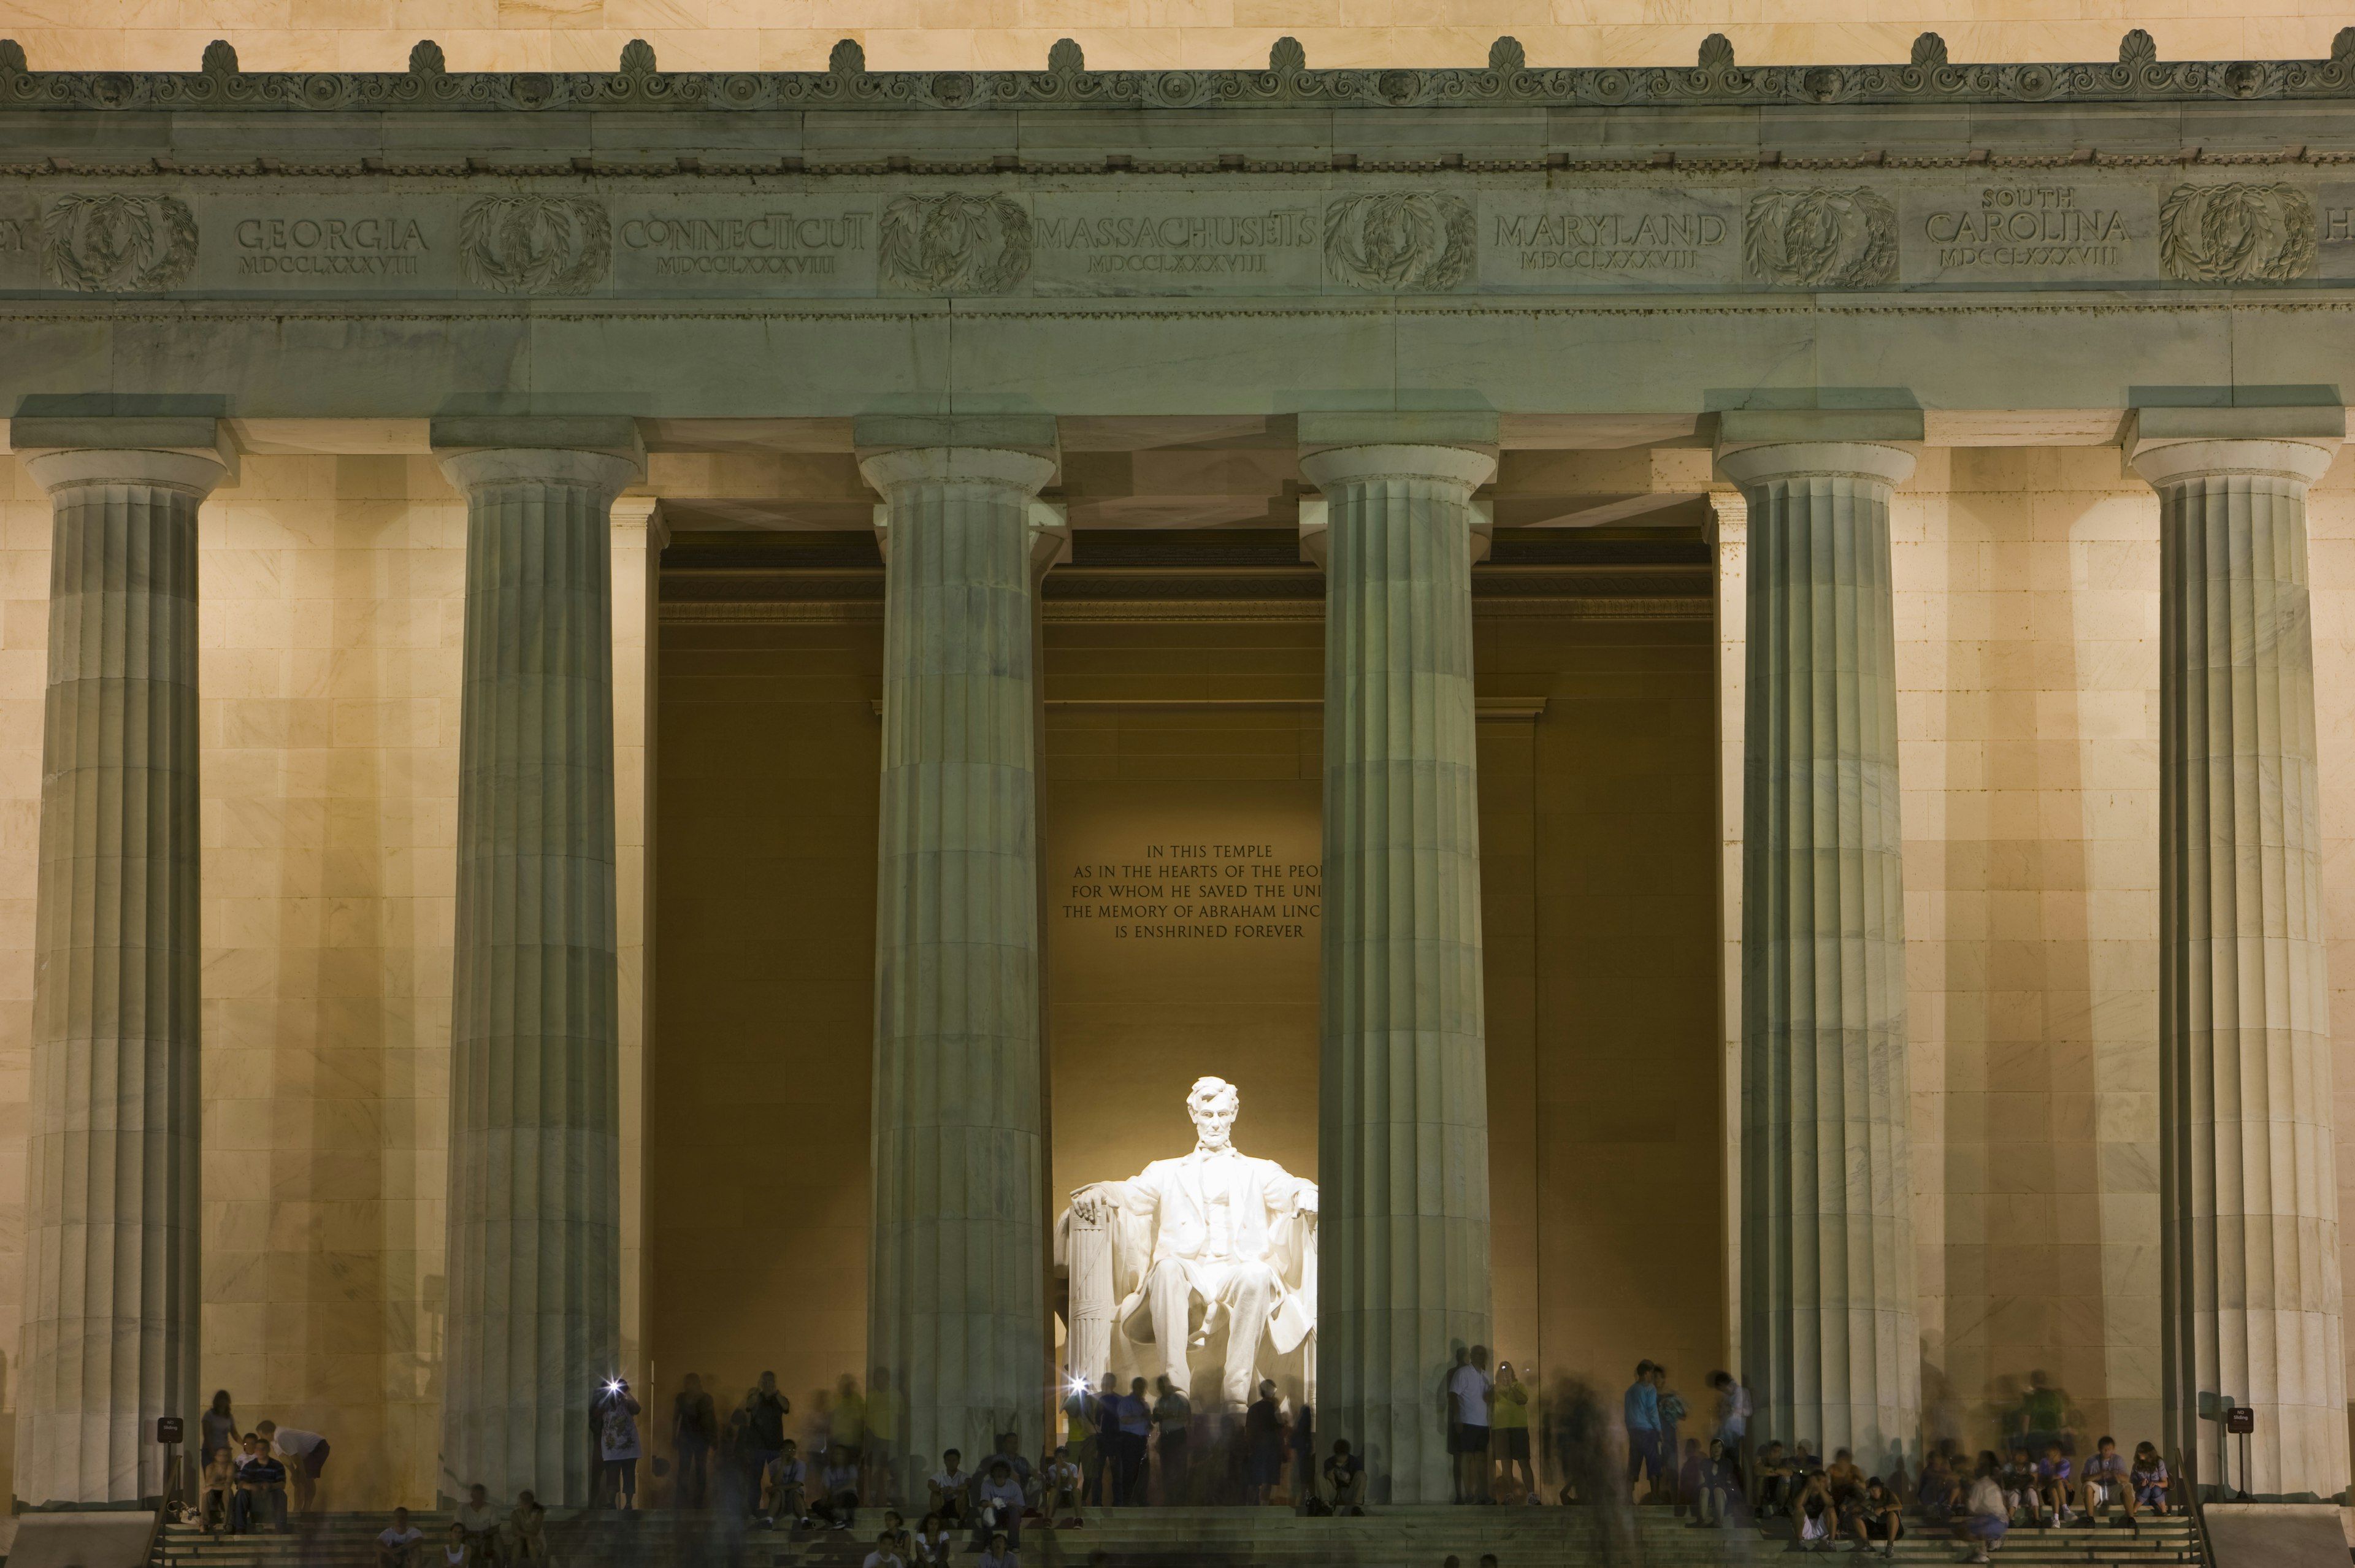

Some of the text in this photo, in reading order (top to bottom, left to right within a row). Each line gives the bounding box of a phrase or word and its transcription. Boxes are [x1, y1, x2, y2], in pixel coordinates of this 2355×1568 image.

[1982, 187, 2075, 209] SOUTH
[234, 218, 429, 251] GEORGIA
[619, 212, 873, 251] CONNECTICUT
[1034, 210, 1317, 248] MASSACHUSETTS
[1495, 214, 1727, 246] MARYLAND
[1924, 210, 2133, 243] CAROLINA
[238, 256, 418, 275] MDCCLXXXVIII
[656, 256, 835, 275] MDCCLXXXVIII
[1088, 254, 1267, 273] MDCCLXXXVIII
[1521, 251, 1698, 269] MDCCLXXXVIII
[1939, 247, 2118, 266] MDCCLXXXVIII
[1147, 845, 1273, 858] IN THIS TEMPLE
[1074, 865, 1092, 878] AS
[1098, 865, 1115, 878] IN
[1122, 865, 1152, 878] THE
[1158, 865, 1217, 878] HEARTS
[1225, 865, 1245, 878] OF
[1251, 865, 1282, 878] THE
[1072, 885, 1103, 898] FOR
[1109, 885, 1163, 898] WHOM
[1171, 885, 1191, 898] HE
[1199, 885, 1247, 898] SAVED
[1254, 885, 1285, 898] THE
[1063, 905, 1092, 918] THE
[1098, 905, 1168, 918] MEMORY
[1174, 905, 1193, 918] OF
[1198, 905, 1276, 918] ABRAHAM
[1115, 925, 1306, 938] IS ENSHRINED FOREVER
